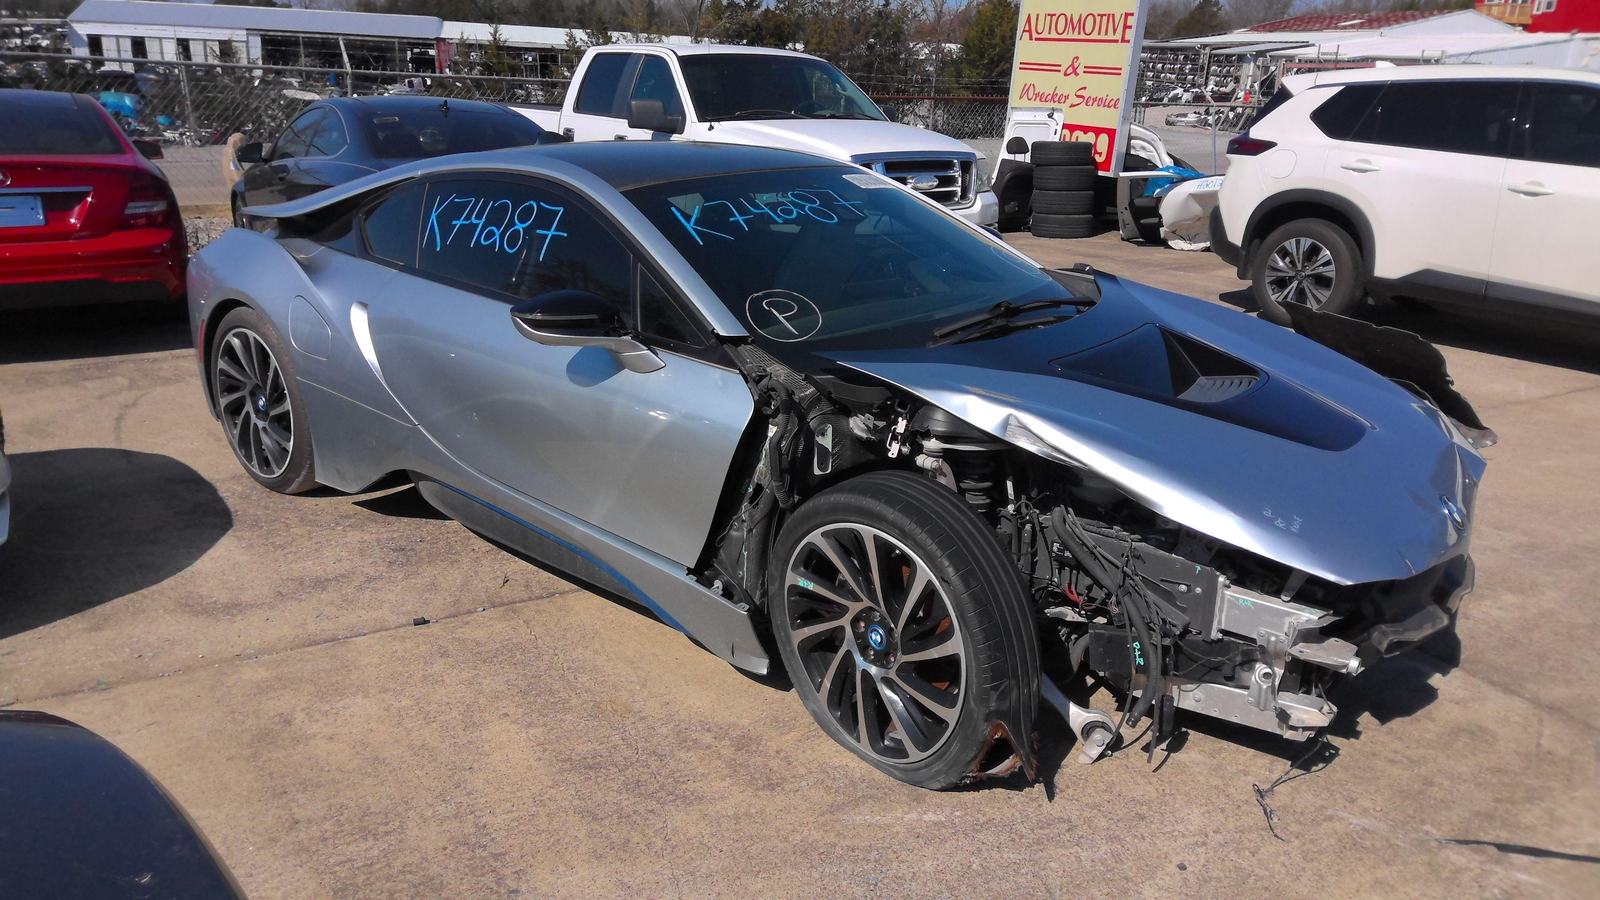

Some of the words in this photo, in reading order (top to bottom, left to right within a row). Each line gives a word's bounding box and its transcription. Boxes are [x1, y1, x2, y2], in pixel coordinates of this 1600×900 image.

[1019, 12, 1135, 43] AUTOMOTIVE
[1063, 56, 1081, 77] &
[1019, 83, 1070, 104] Wrecker
[1069, 86, 1120, 110] Service
[422, 193, 568, 262] K74287
[671, 188, 865, 245] K74287
